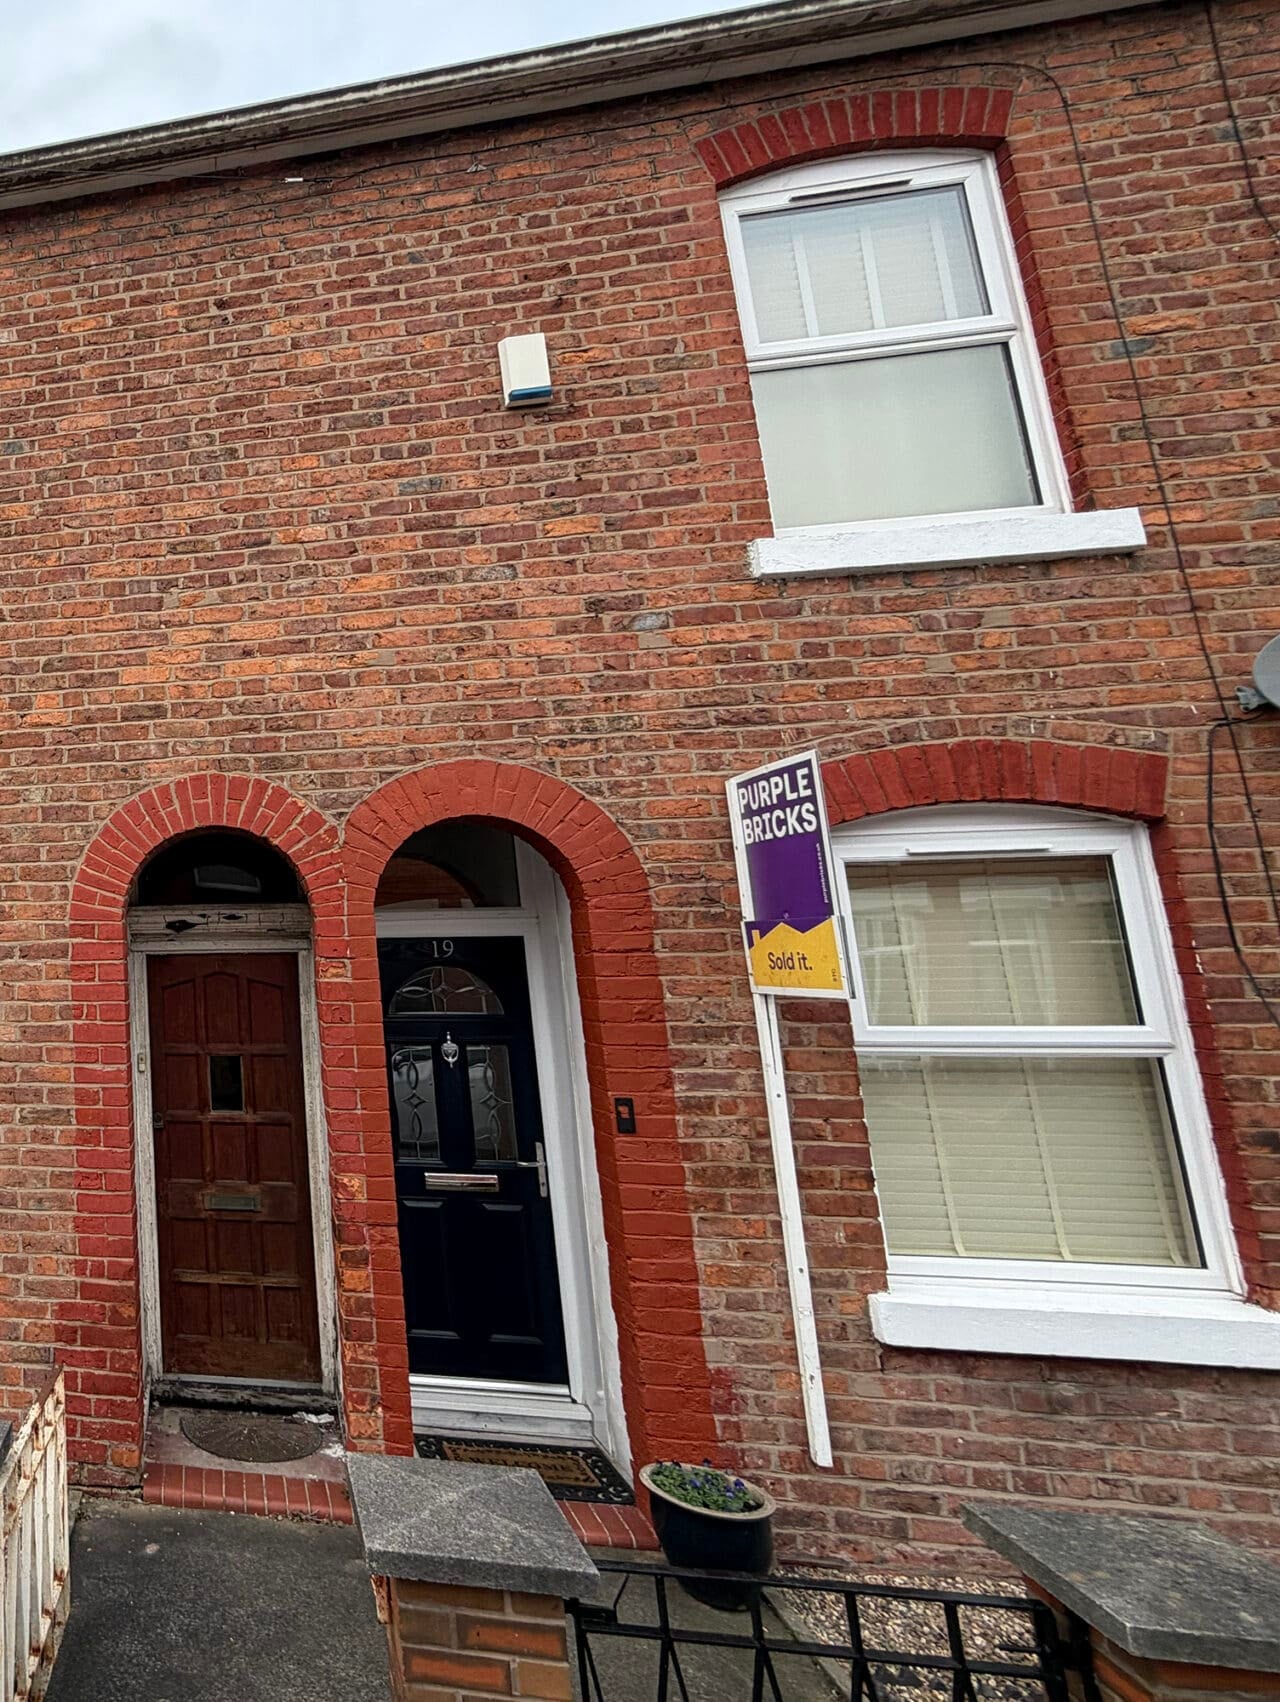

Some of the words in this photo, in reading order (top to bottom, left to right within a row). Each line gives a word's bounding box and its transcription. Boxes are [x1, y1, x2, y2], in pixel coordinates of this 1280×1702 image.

[738, 767, 812, 813] PURPLE
[742, 802, 817, 844] BRICKS
[432, 940, 454, 958] 19
[767, 951, 796, 970] Sold
[797, 951, 813, 970] it.
